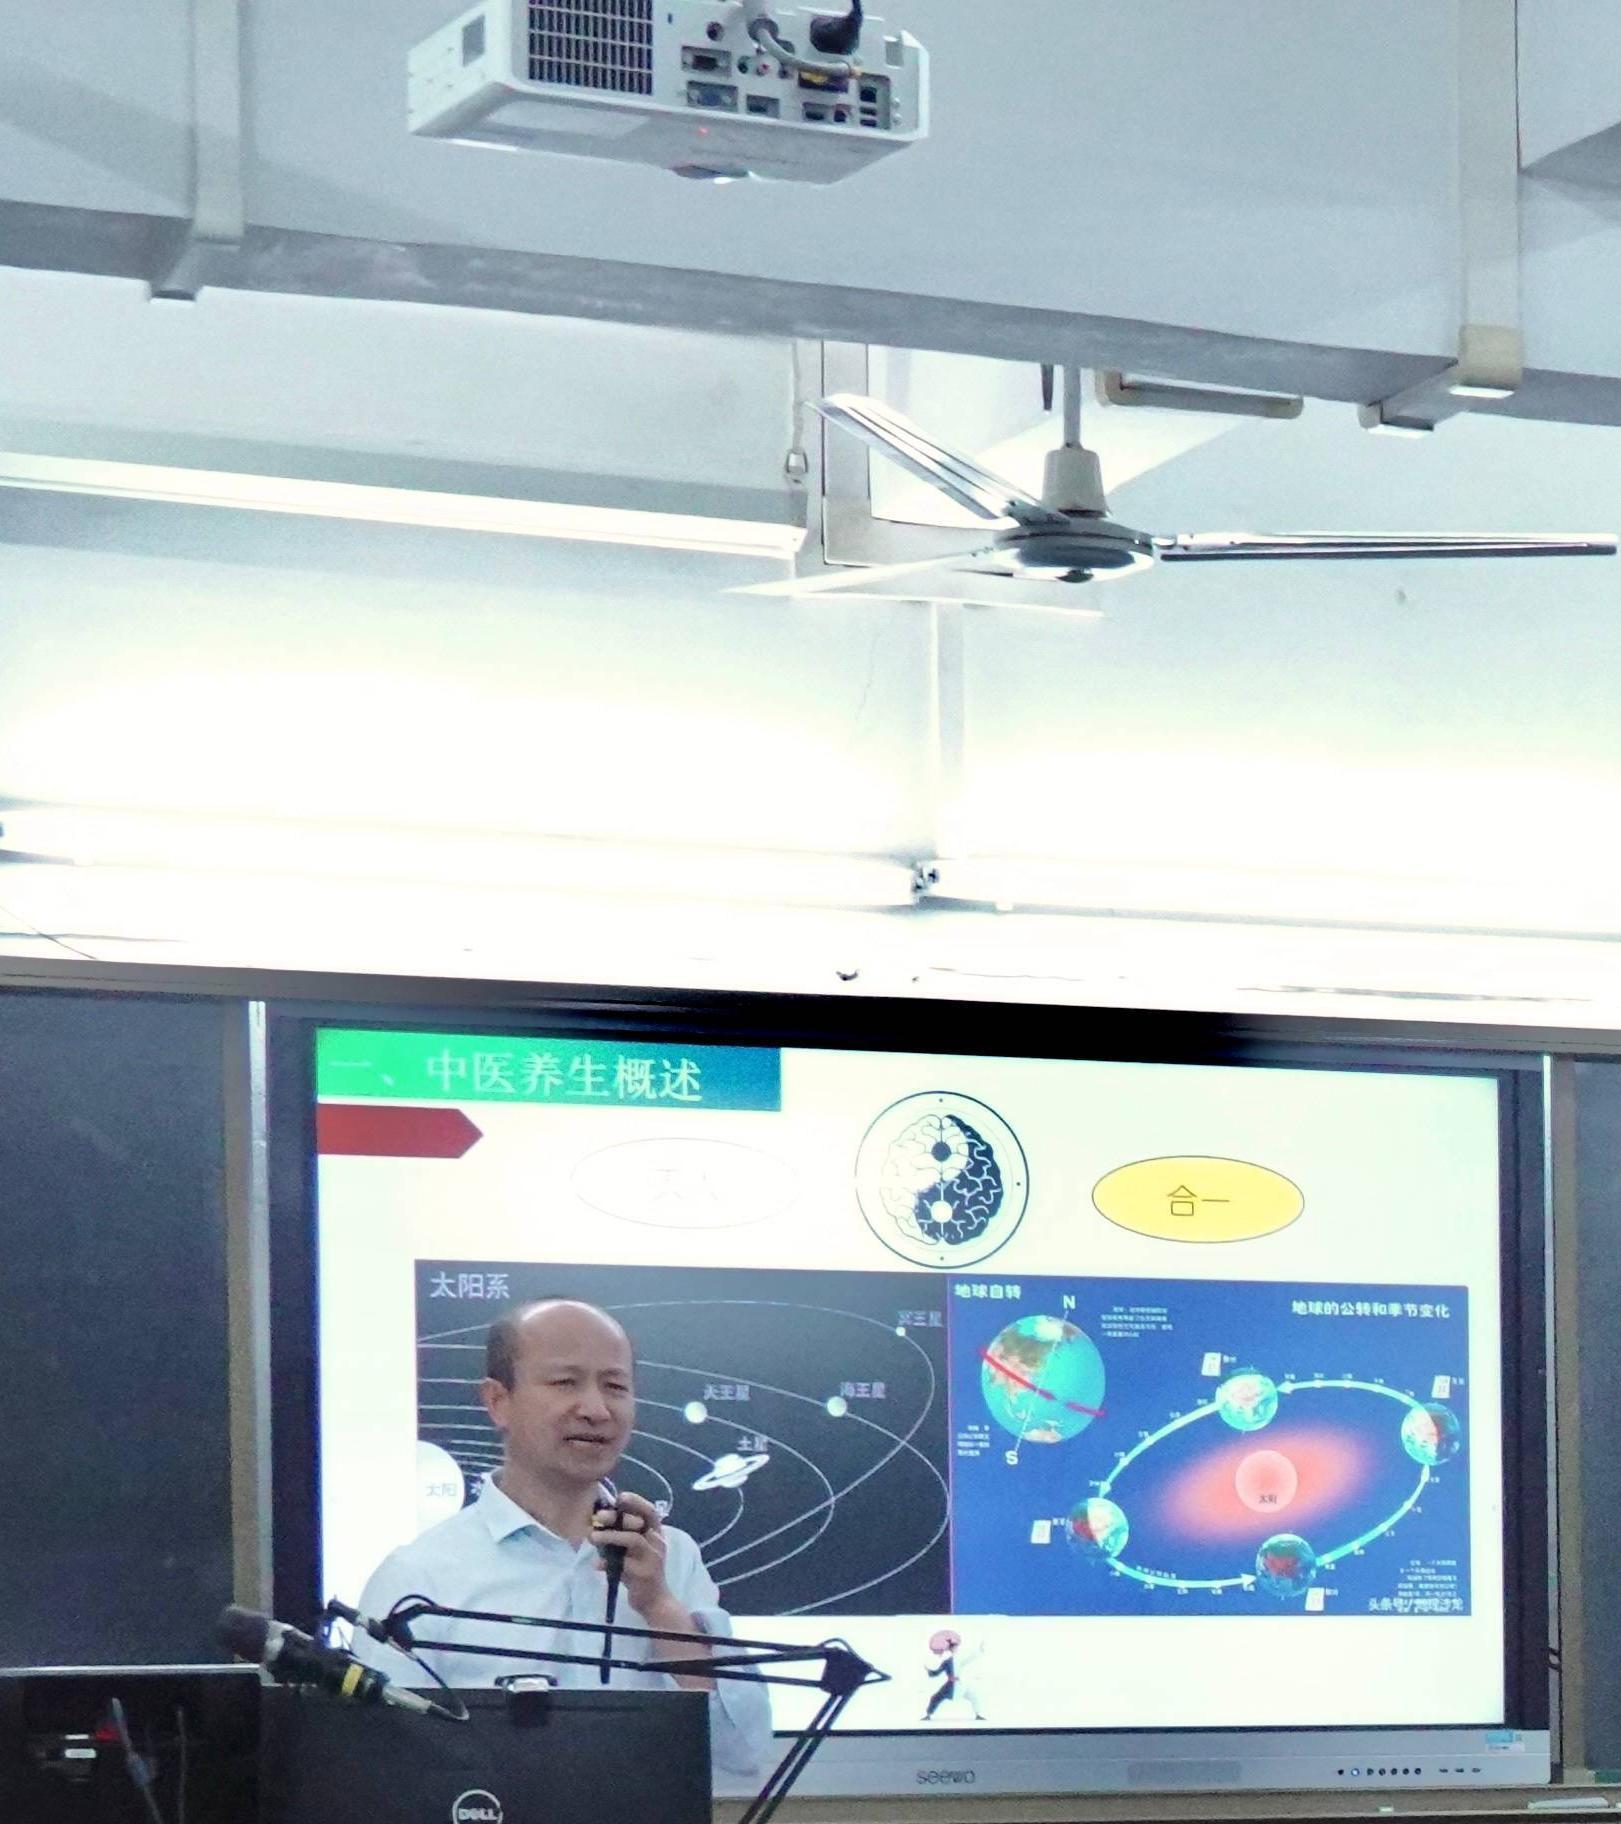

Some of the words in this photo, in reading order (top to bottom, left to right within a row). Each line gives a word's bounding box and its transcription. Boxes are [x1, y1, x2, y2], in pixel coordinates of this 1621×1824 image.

[1167, 1185, 1230, 1216] 合一
[430, 1271, 510, 1299] 太阳系
[954, 1283, 1021, 1300] 地球自转
[1063, 1295, 1076, 1309] N
[1291, 1300, 1450, 1318] 地球的公转和季节变化
[1005, 1450, 1018, 1465] S
